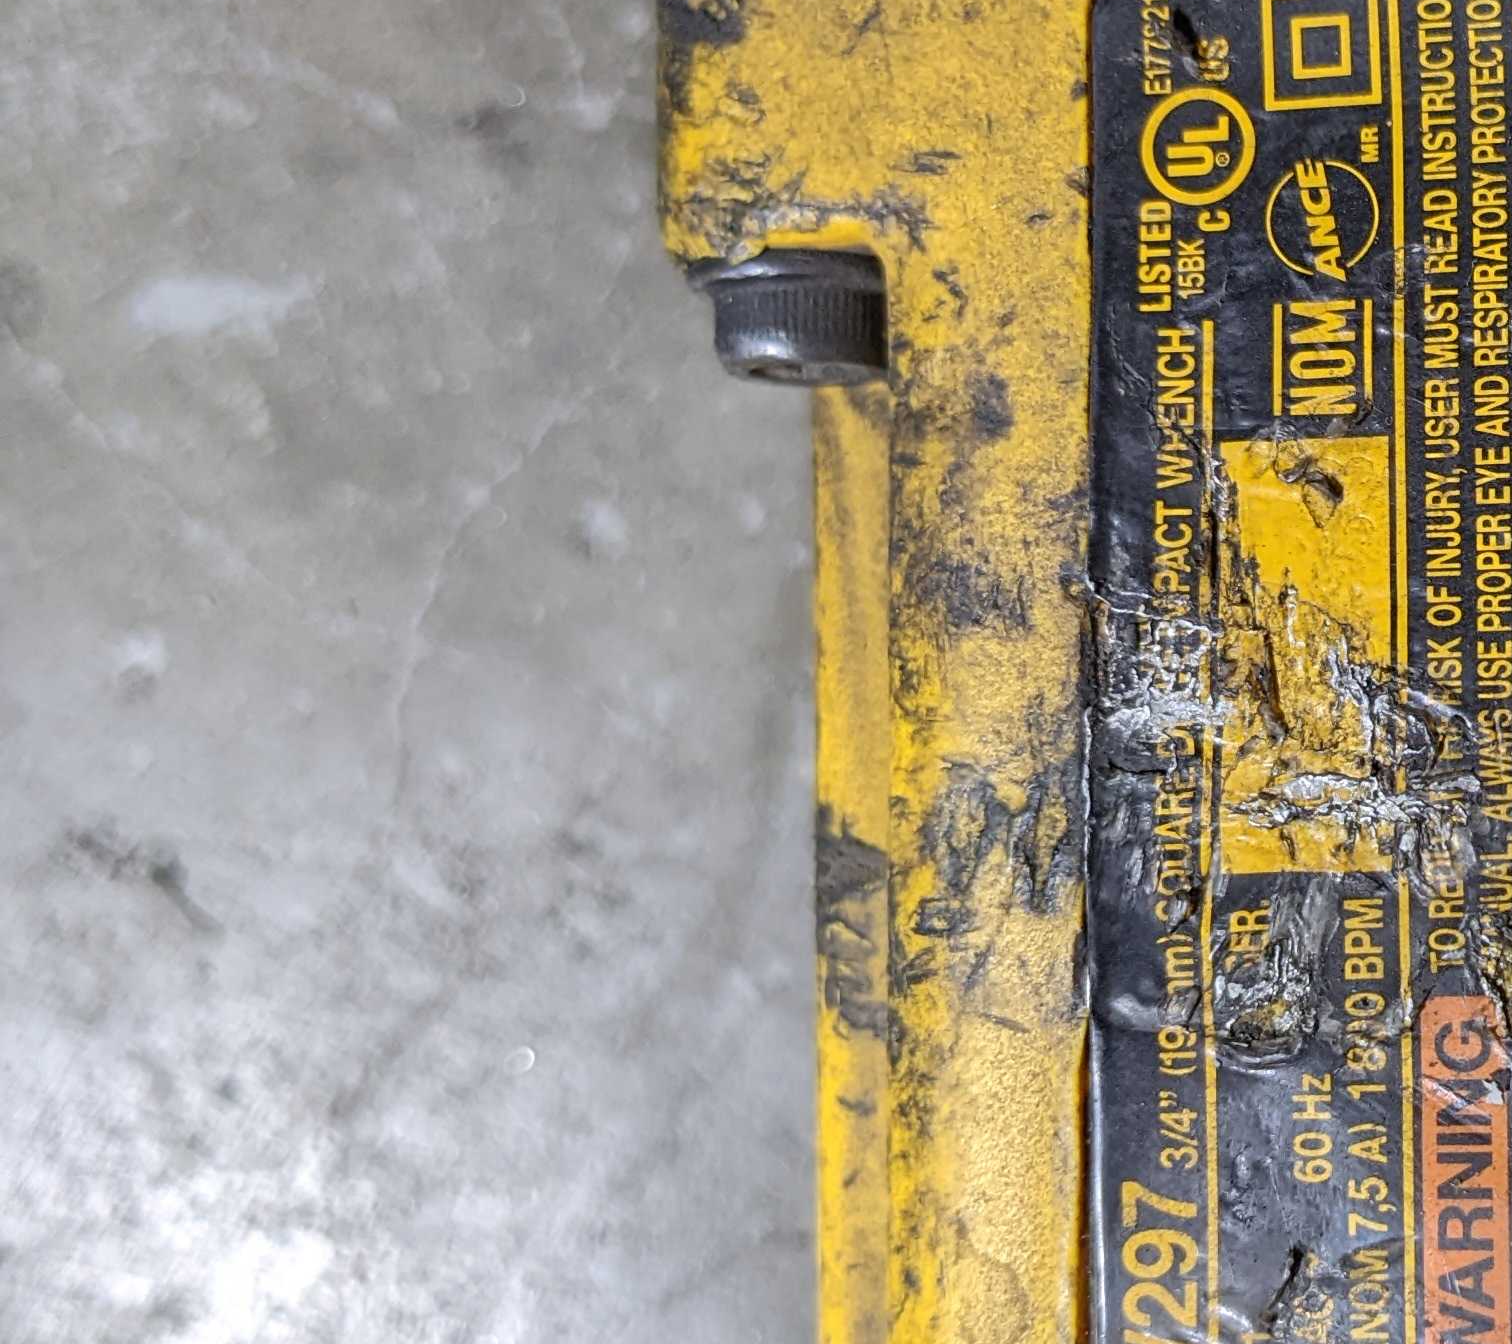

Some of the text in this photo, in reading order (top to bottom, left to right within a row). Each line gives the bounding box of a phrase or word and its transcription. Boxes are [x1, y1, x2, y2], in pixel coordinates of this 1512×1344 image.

[1198, 36, 1230, 82] US
[1166, 115, 1230, 178] UL
[1361, 125, 1380, 163] MR
[1139, 200, 1172, 312] LISTED
[1293, 157, 1349, 282] ANCE
[1421, 189, 1458, 274] READ
[1177, 239, 1206, 299] 15BK
[1471, 170, 1508, 367] RESPIRATORY
[1288, 299, 1358, 416] NOM
[1423, 284, 1459, 369] MUST
[1423, 377, 1462, 459] USER
[1471, 374, 1510, 436] AND
[1474, 446, 1511, 505] EYE
[1424, 467, 1465, 577] INJURY,
[1426, 585, 1462, 627] OF
[1475, 514, 1512, 632] PROPER
[1343, 897, 1386, 980] BPM
[1428, 927, 1464, 973] TO
[1292, 1072, 1335, 1184] 60 Hz
[1346, 1122, 1390, 1164] A)
[1347, 1175, 1398, 1237] 7,5
